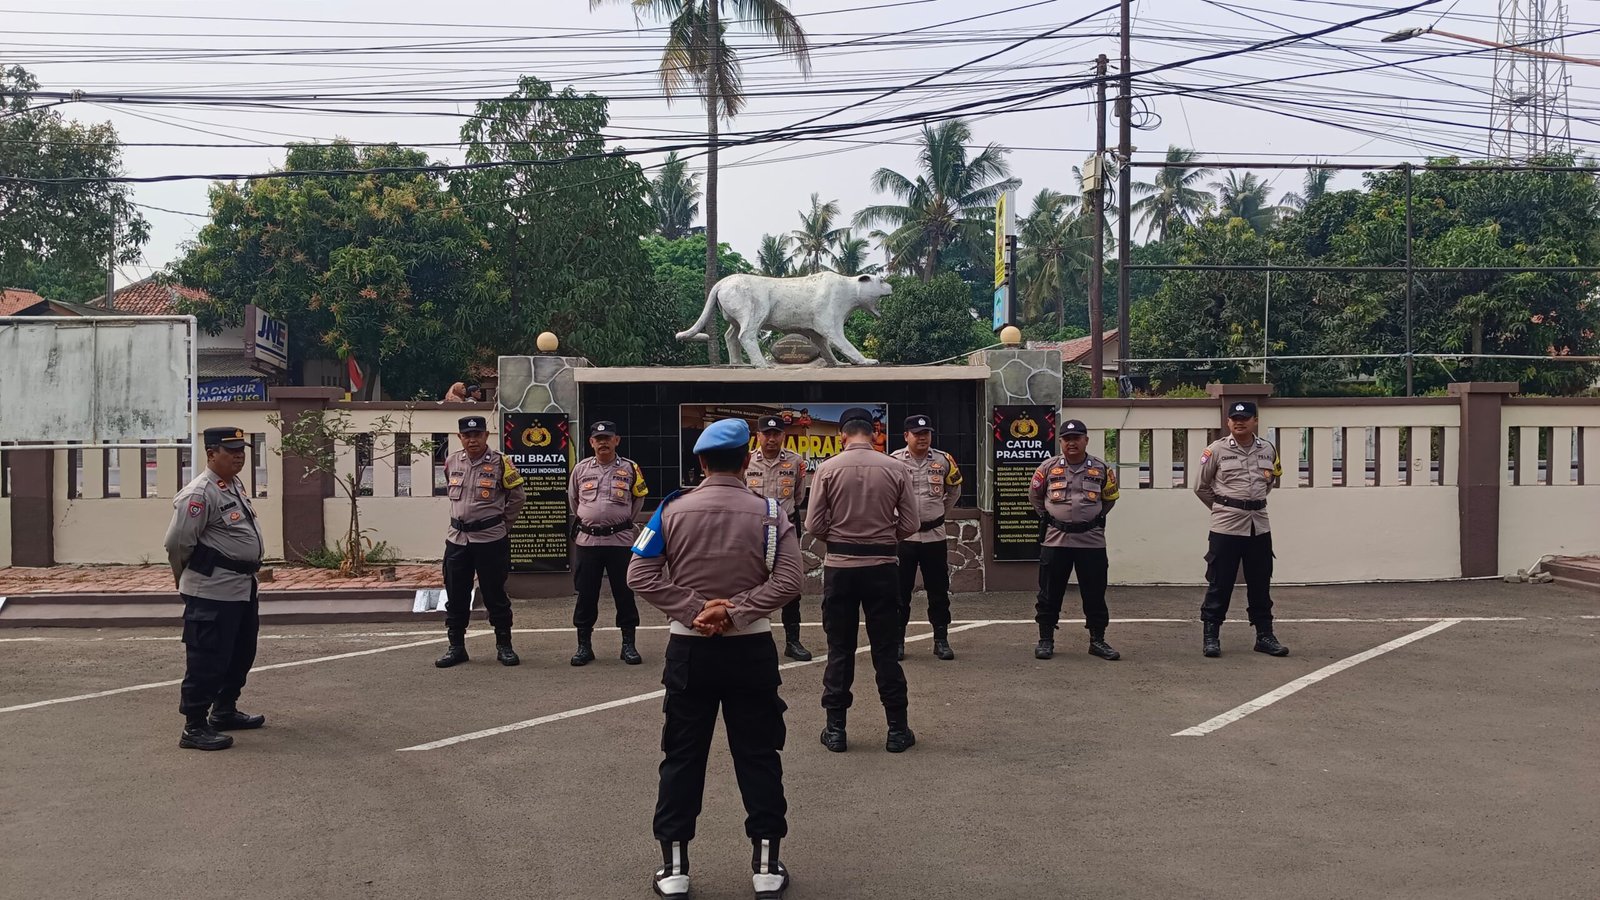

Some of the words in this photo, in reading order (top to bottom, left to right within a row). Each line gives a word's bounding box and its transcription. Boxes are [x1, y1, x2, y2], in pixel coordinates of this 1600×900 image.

[258, 314, 286, 347] JNE
[210, 384, 256, 396] ONGKIR
[1006, 440, 1042, 448] CATUR
[508, 454, 525, 463] TRI
[528, 454, 566, 463] BRATA
[996, 450, 1051, 459] PRASETYA
